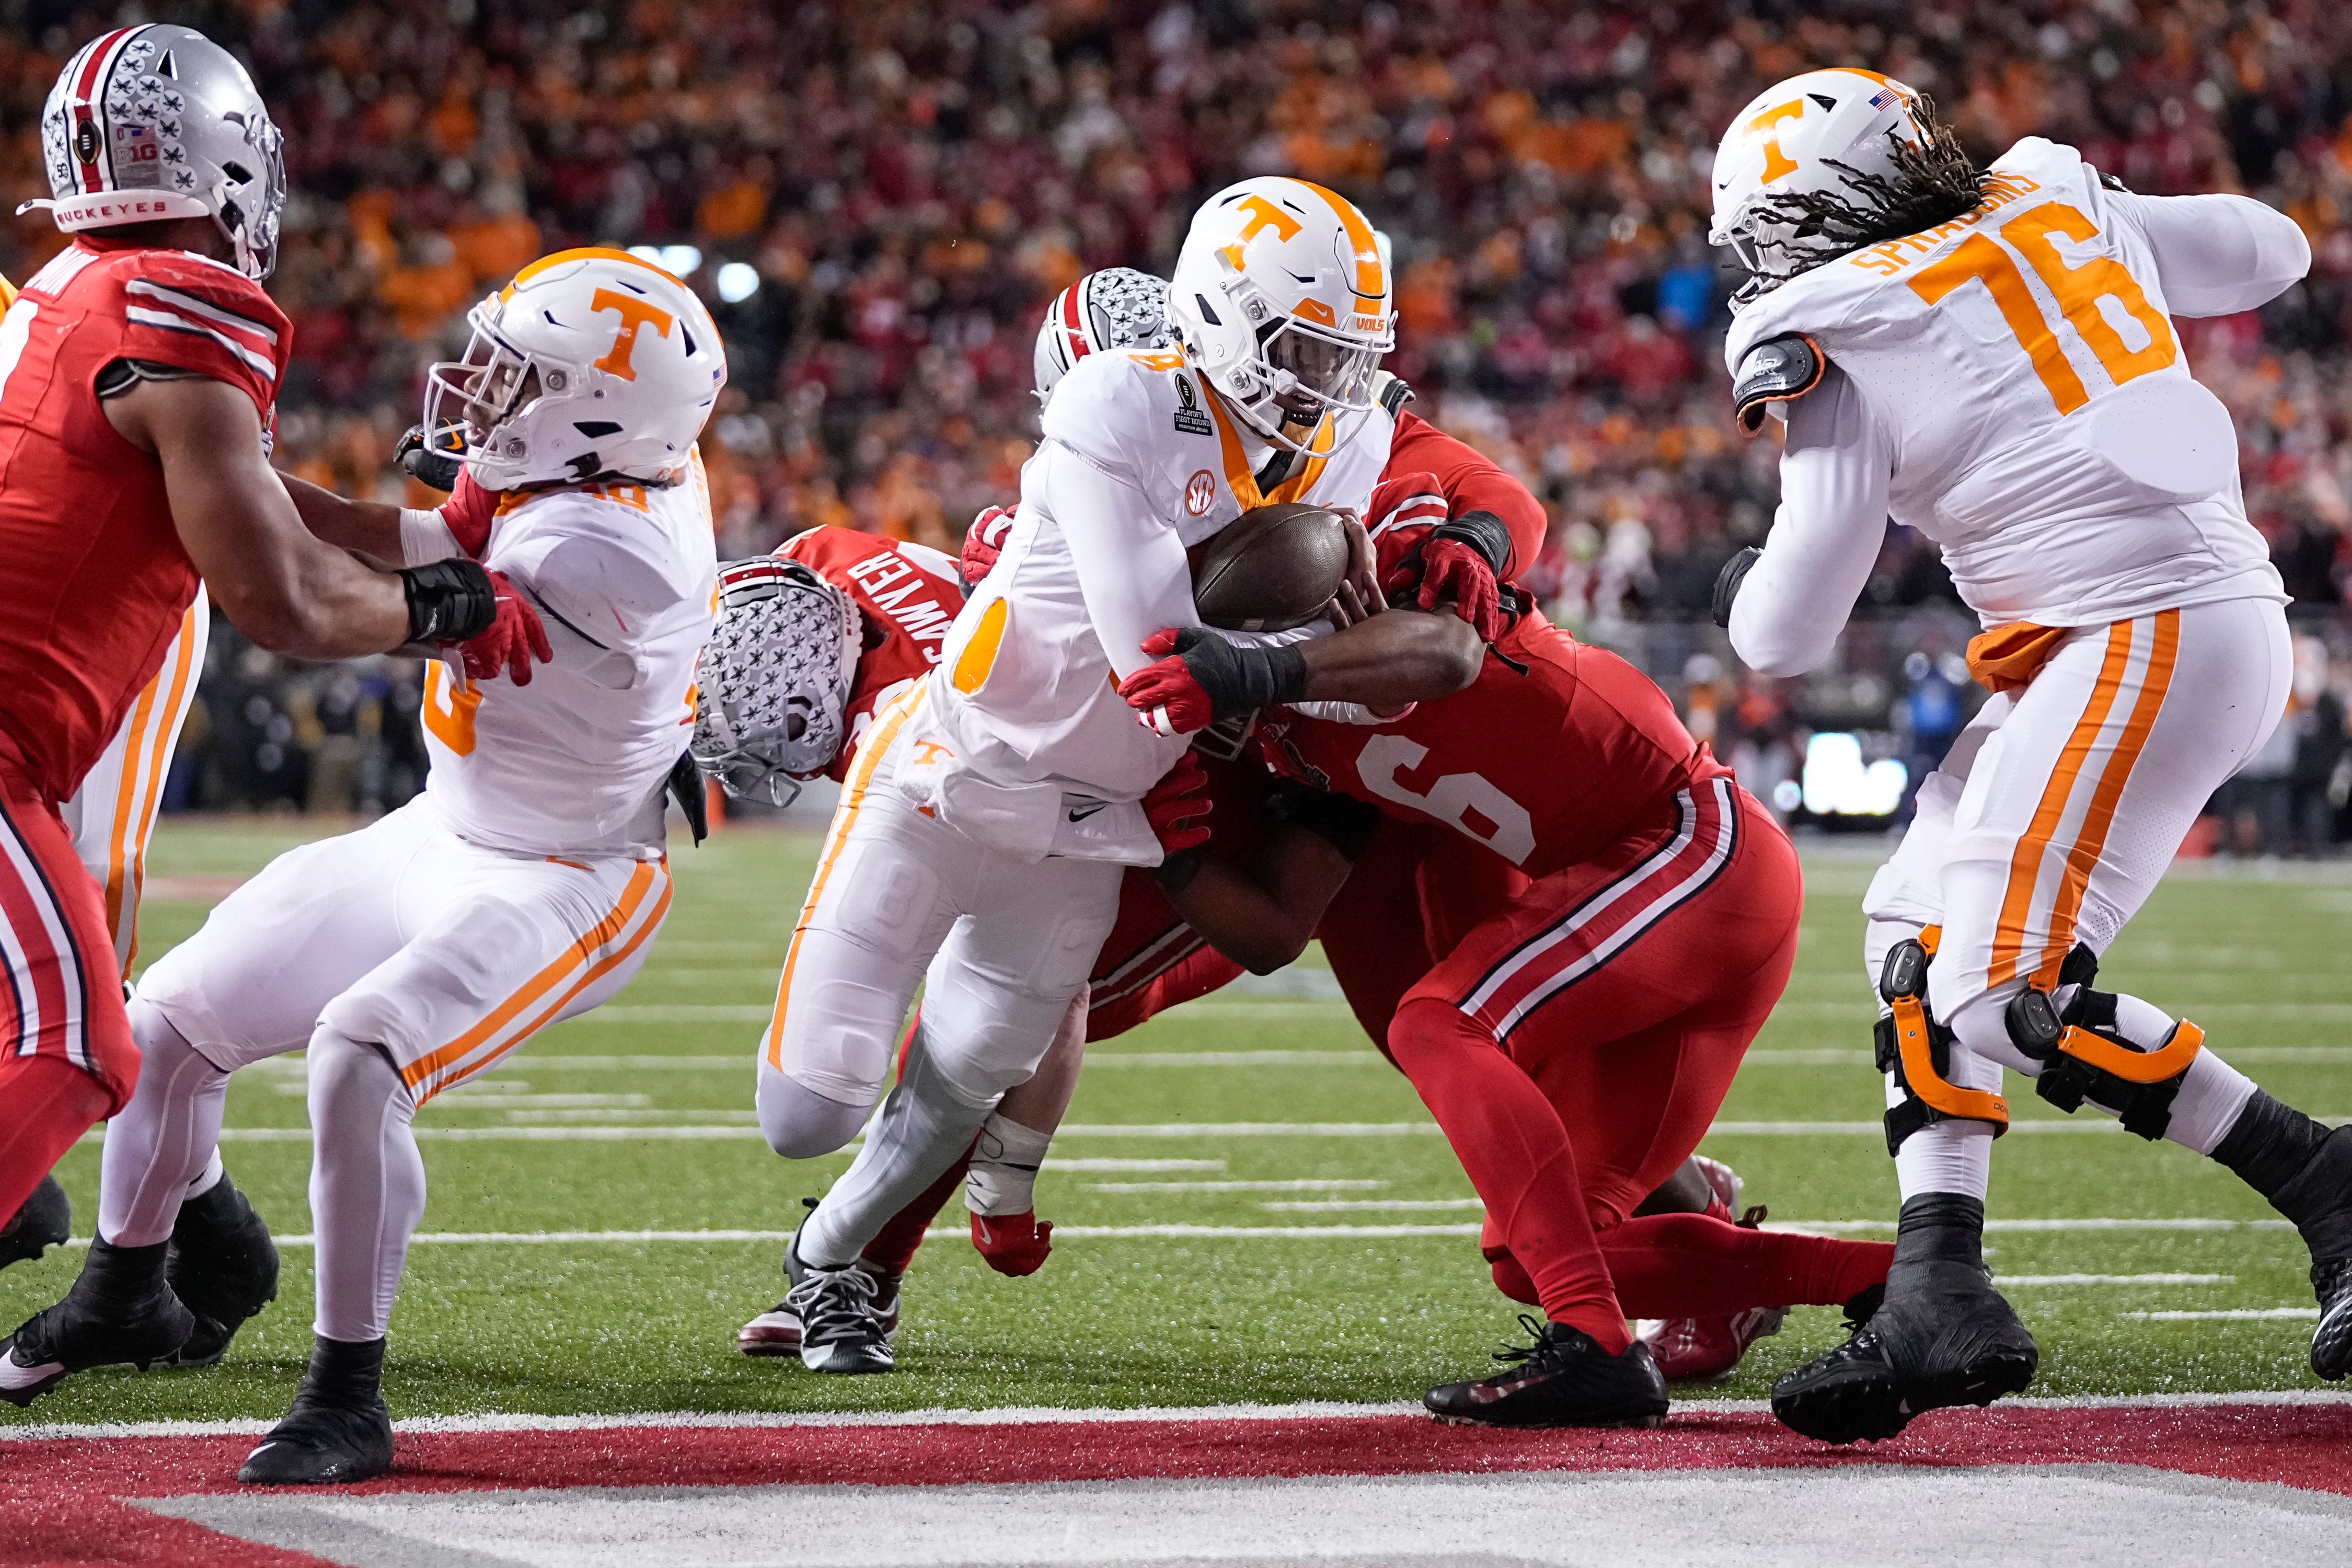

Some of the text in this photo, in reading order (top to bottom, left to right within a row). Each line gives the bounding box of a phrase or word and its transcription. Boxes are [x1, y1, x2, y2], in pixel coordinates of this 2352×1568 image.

[1744, 98, 1804, 185] T
[1221, 195, 1304, 272] T
[591, 287, 673, 383] T
[1356, 317, 1385, 332] VOLS
[1906, 200, 2176, 417] 76
[1175, 415, 1210, 426] FIRST ROUND
[1180, 408, 1203, 418] PLAYOFF
[1188, 474, 1213, 513] SEC
[1355, 733, 1537, 867] 6
